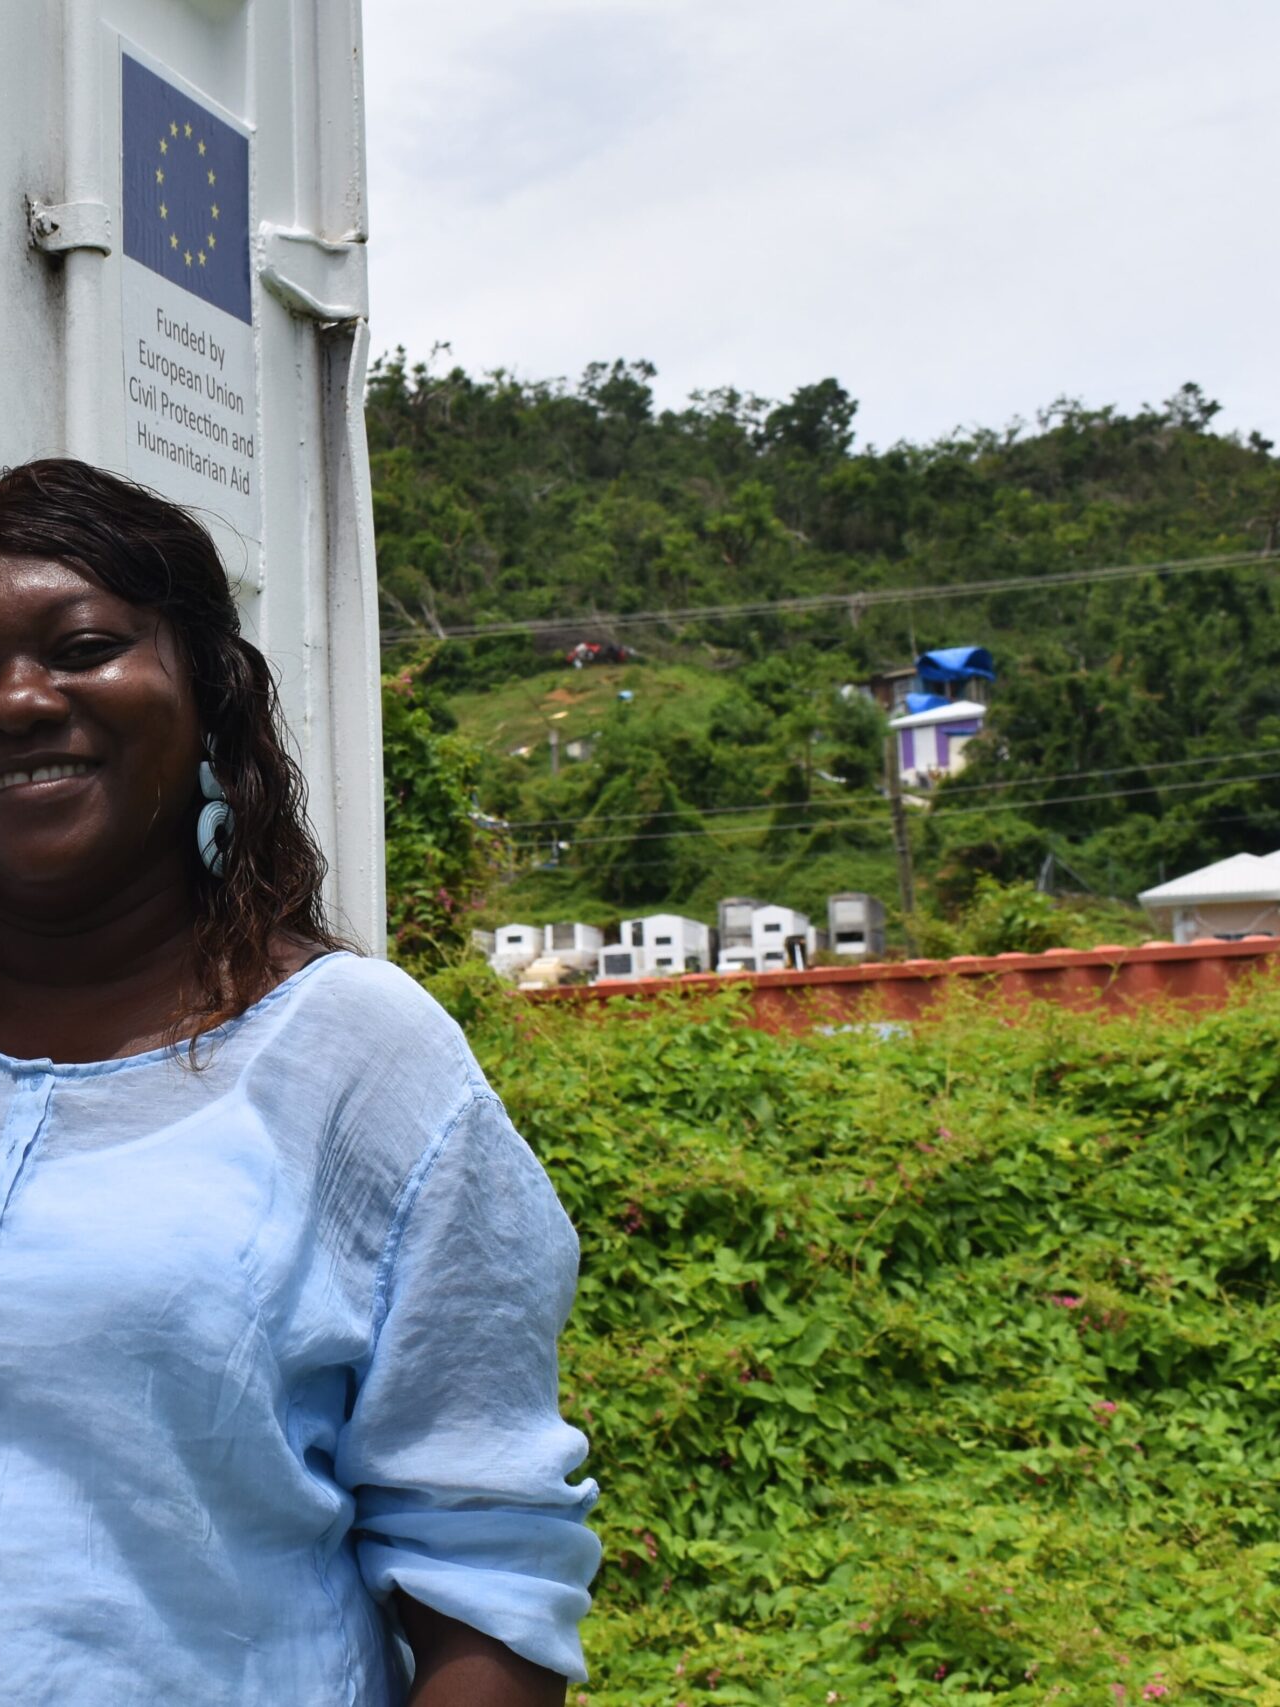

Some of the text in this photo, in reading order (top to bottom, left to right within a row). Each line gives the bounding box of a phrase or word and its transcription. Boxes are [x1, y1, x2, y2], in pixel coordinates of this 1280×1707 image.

[139, 339, 243, 414] European Union
[157, 308, 225, 371] Funded by
[129, 376, 254, 458] Civil Protection and
[138, 421, 249, 496] Humanitarian Aid
